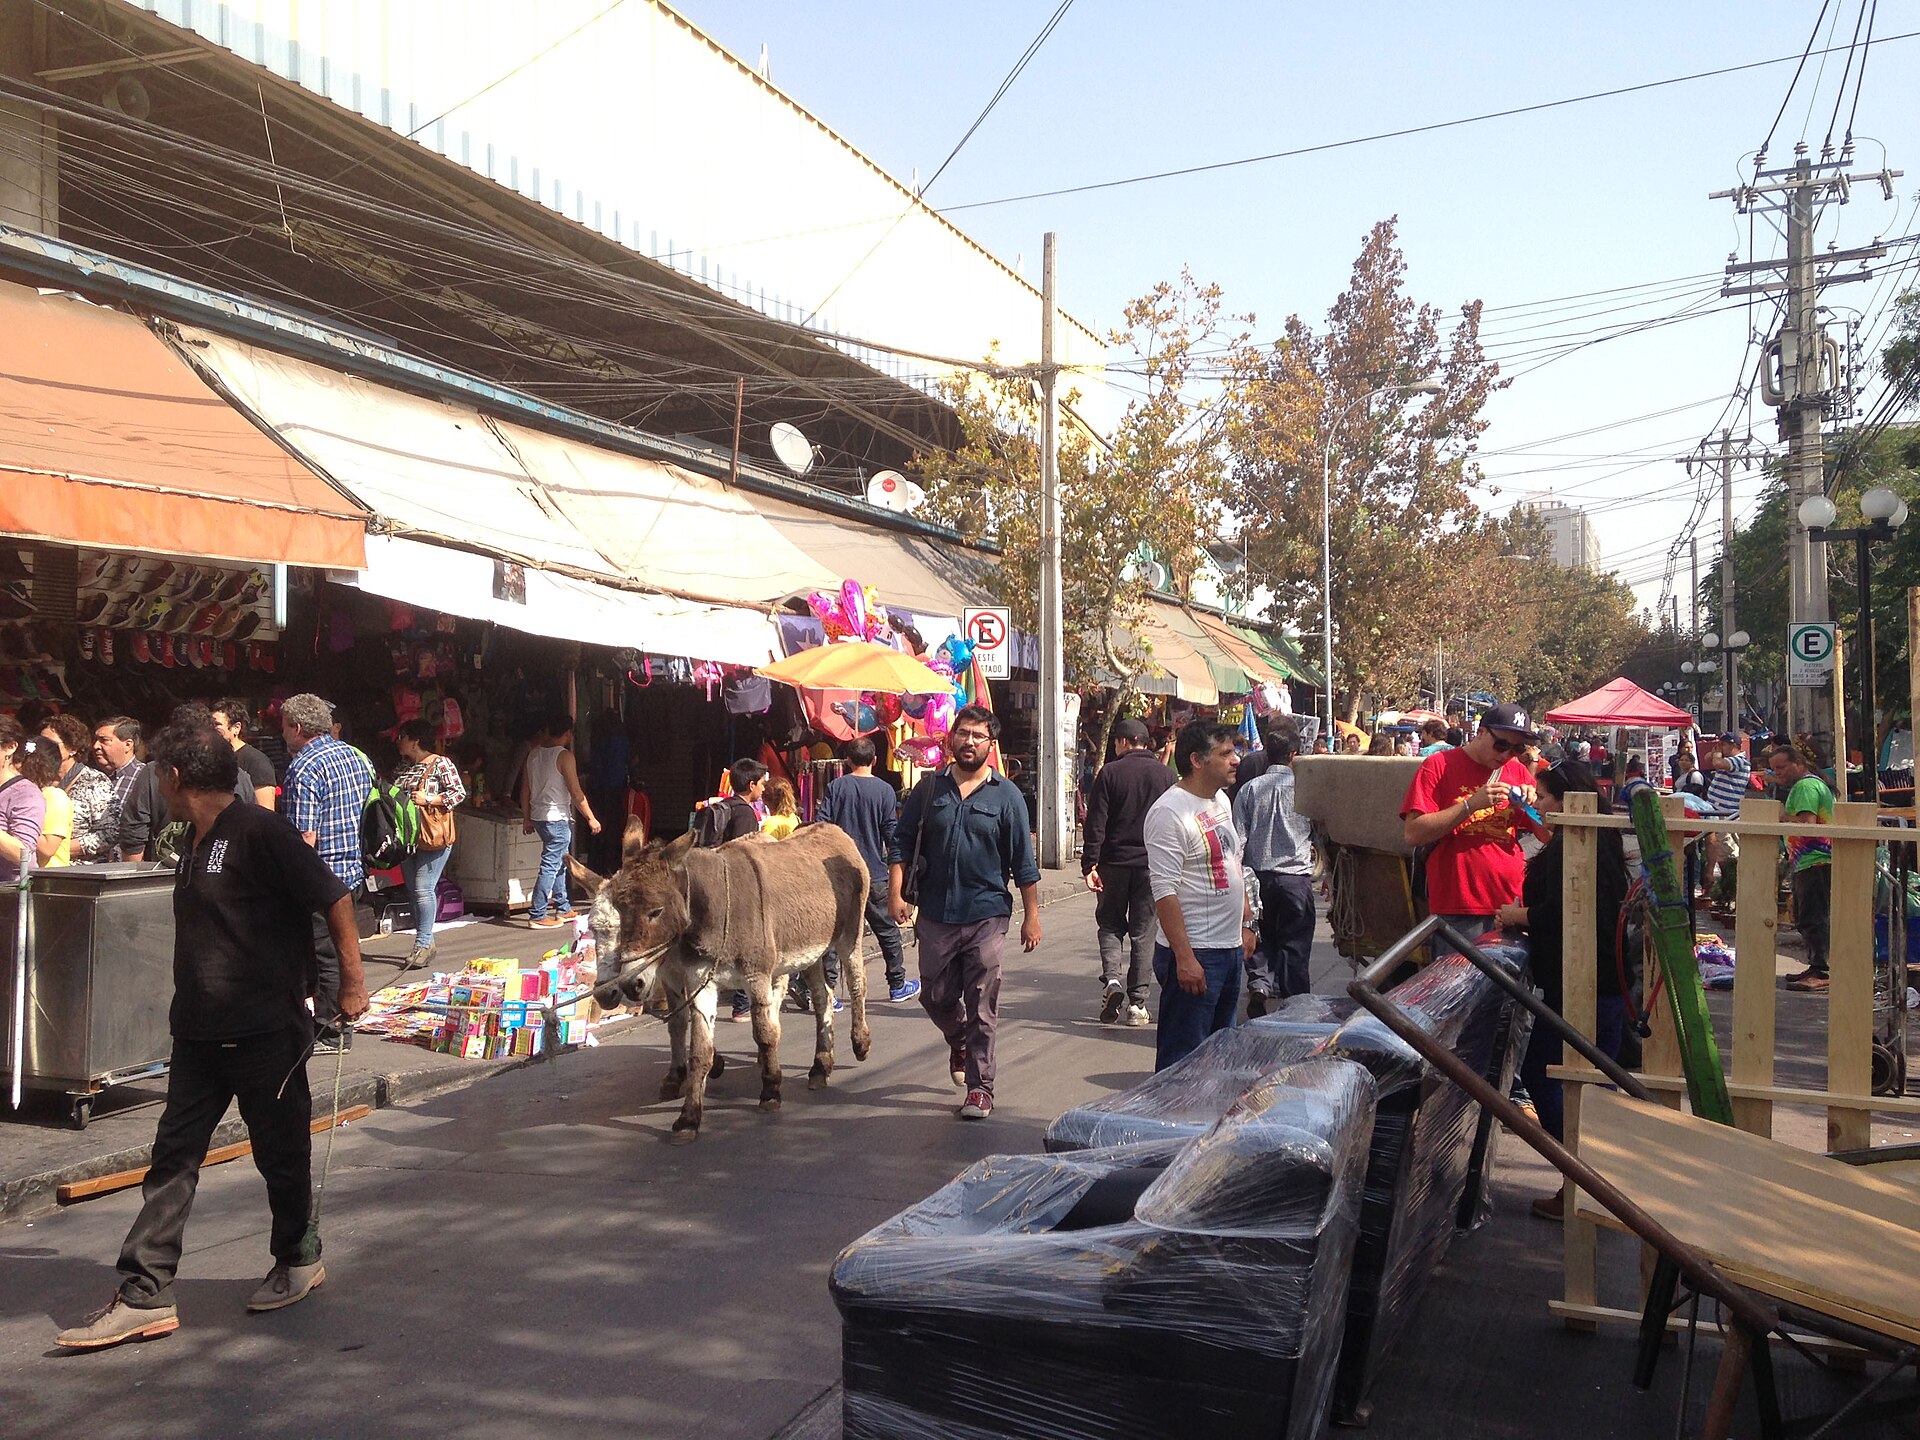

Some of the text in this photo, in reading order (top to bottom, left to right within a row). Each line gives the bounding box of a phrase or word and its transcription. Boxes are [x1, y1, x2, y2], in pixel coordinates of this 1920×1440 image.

[979, 619, 994, 643] E
[1804, 633, 1820, 654] E
[978, 654, 995, 662] ESTE
[980, 664, 1002, 673] STADO
[1692, 706, 1698, 714] E
[1513, 712, 1526, 727] NY
